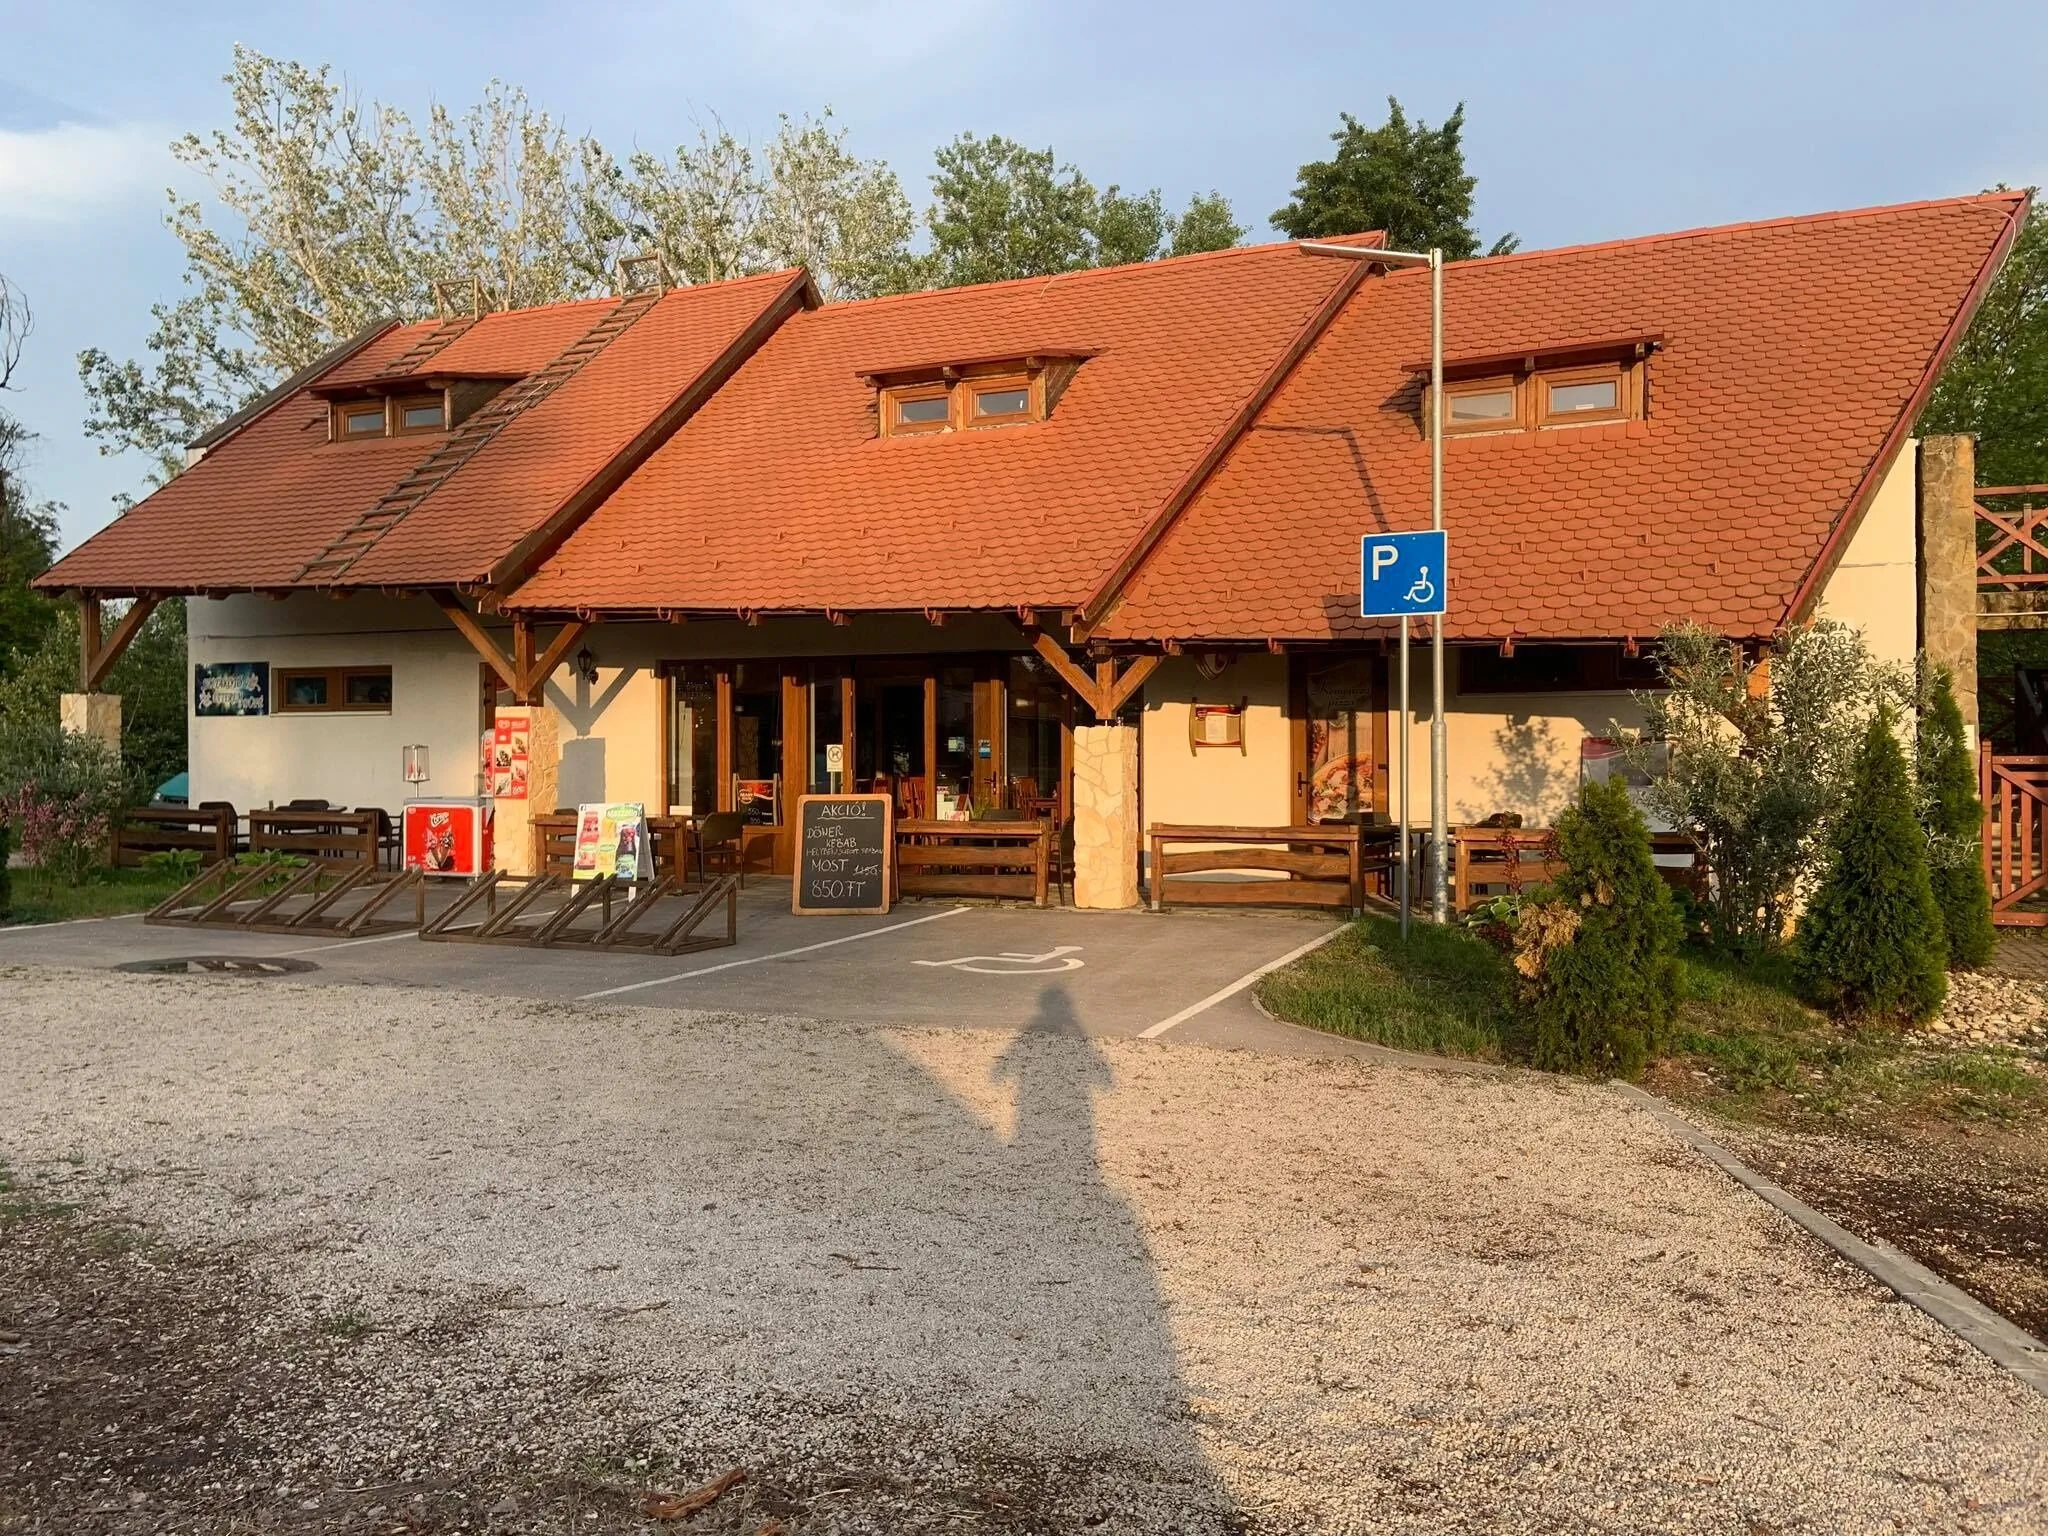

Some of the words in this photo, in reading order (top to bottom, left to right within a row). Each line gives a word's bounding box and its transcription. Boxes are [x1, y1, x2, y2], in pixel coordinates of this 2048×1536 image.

[1373, 545, 1398, 580] P
[821, 801, 867, 817] AKCIÓ!
[807, 825, 844, 839] DÖNER
[826, 837, 857, 848] KEBAB
[811, 858, 849, 872] MOST
